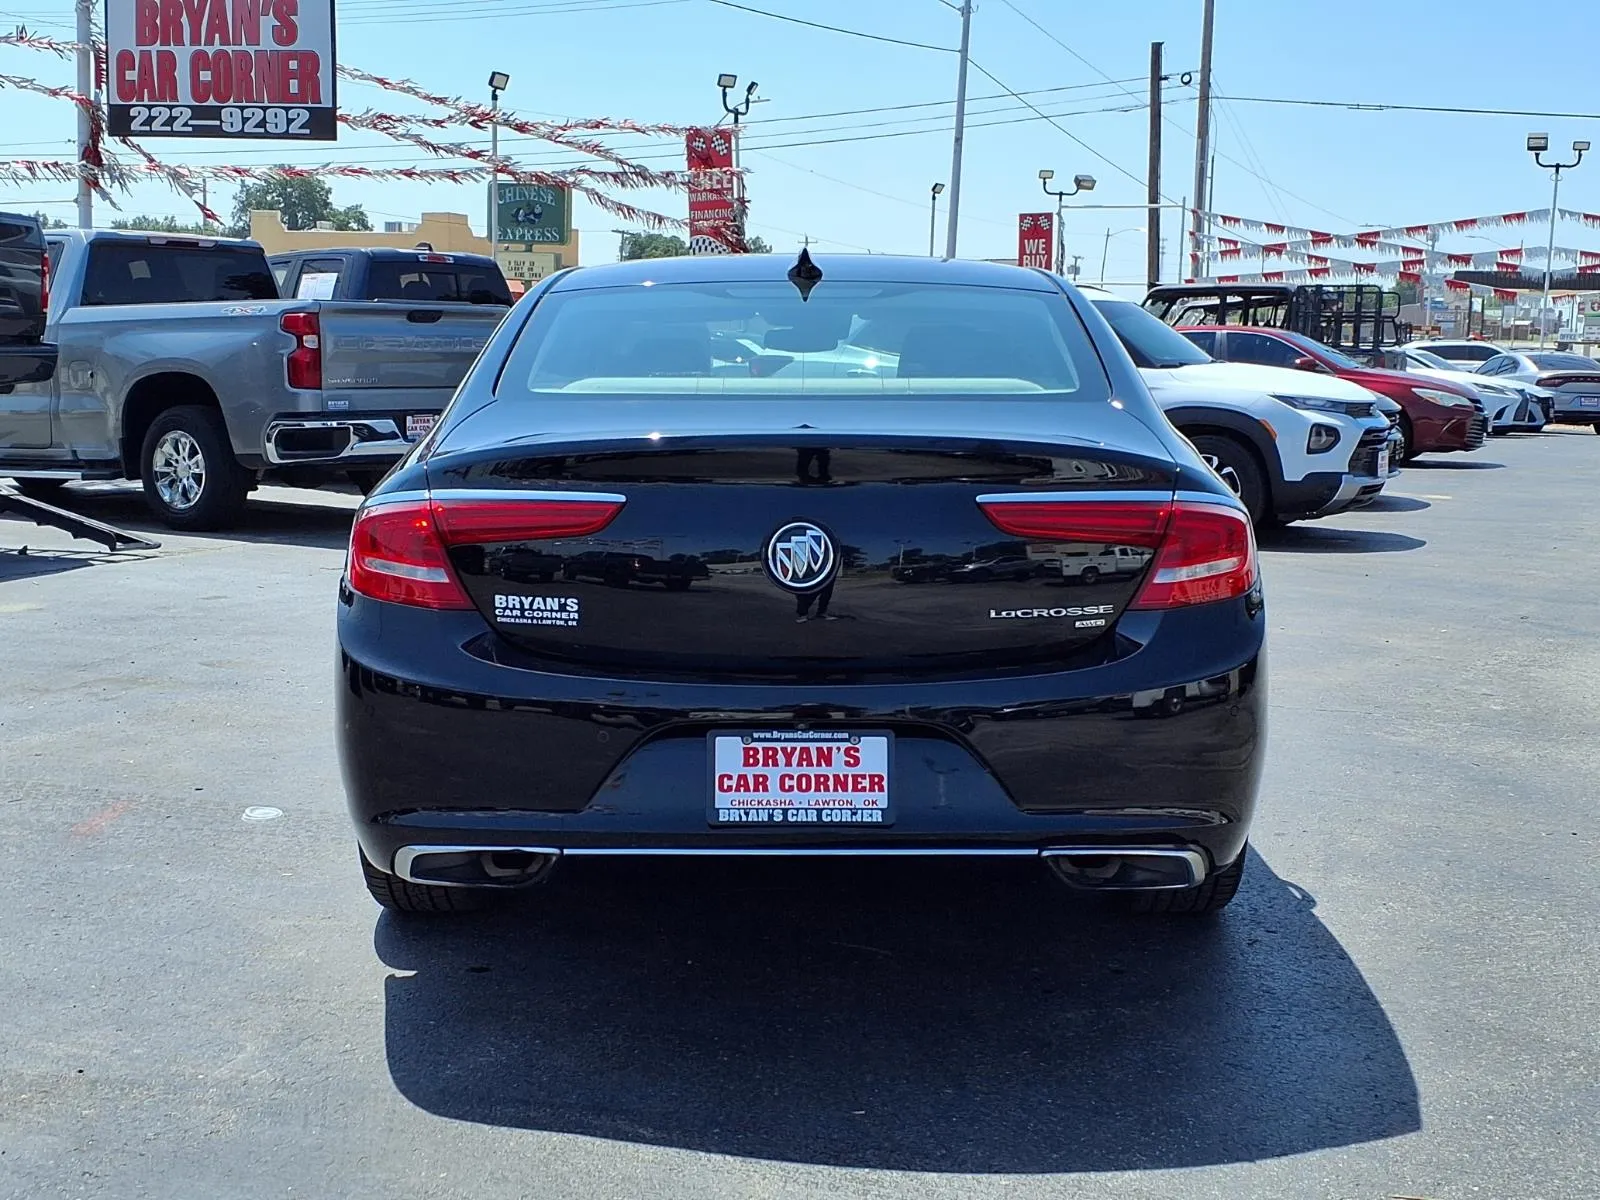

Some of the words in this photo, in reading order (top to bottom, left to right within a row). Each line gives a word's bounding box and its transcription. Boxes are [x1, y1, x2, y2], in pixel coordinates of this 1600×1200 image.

[135, 0, 299, 47] BRYAN'S
[116, 49, 179, 103] CAR
[189, 49, 322, 104] CORNER
[129, 106, 311, 134] 222-9292
[497, 185, 556, 206] CHINESE
[690, 209, 733, 219] FINANCING
[497, 227, 560, 242] EXPRESS
[1024, 239, 1046, 254] WE
[1023, 254, 1048, 269] BUY
[494, 594, 579, 611] BRYAN'S
[495, 609, 521, 617] CAR
[524, 611, 579, 619] CORNER
[989, 604, 1114, 618] LaCROSSE
[752, 730, 849, 741] www.BryansCarCorner.com
[742, 746, 861, 768] BRYAN'S
[717, 773, 769, 793] CAR
[779, 773, 886, 793] CORNER
[730, 799, 795, 807] CHICKASHA
[807, 799, 857, 808] LAWTON,
[863, 799, 879, 807] OK
[718, 809, 783, 822] BRYAN'S
[787, 810, 818, 822] CAR
